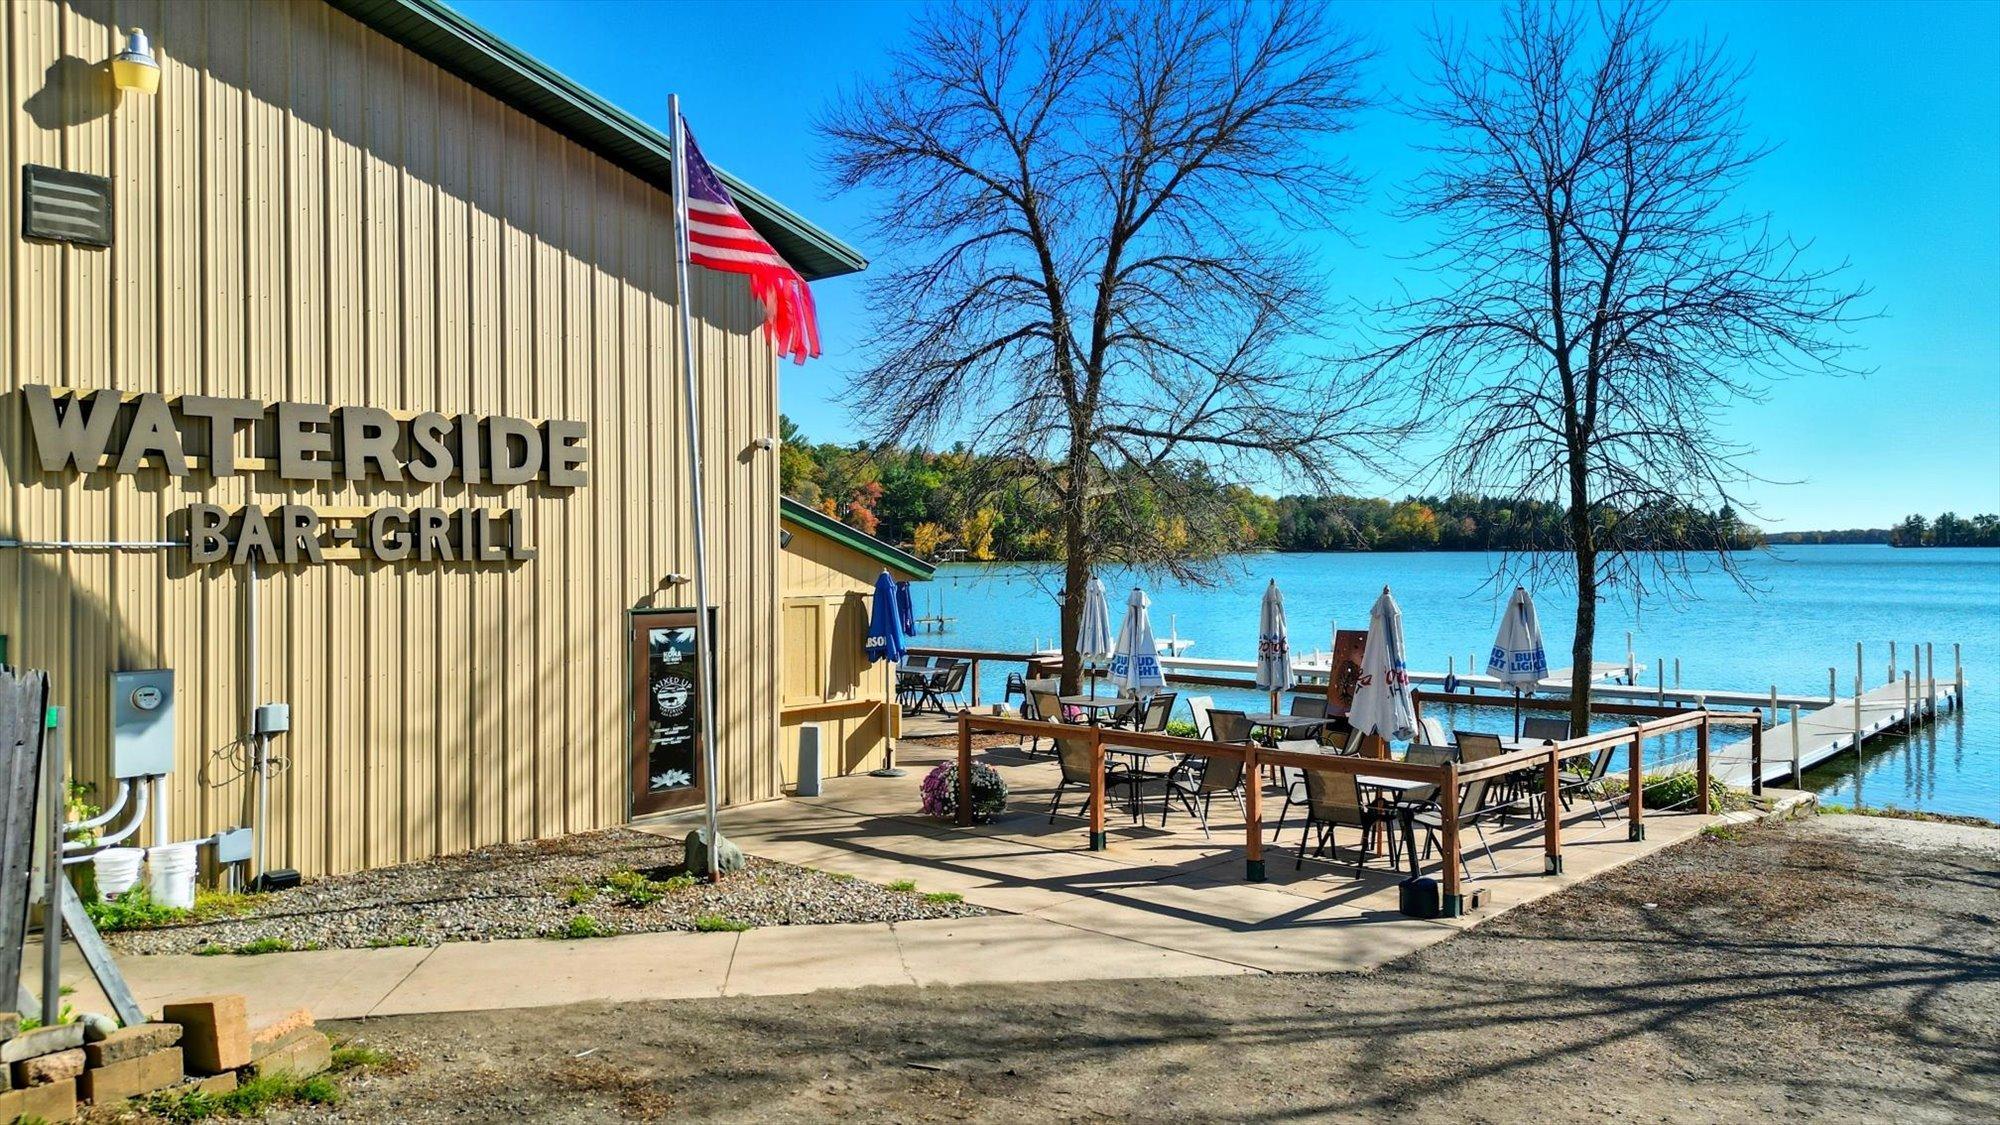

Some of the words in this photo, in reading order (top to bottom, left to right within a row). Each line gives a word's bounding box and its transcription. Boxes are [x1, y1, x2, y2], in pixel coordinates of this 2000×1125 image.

[24, 383, 588, 487] WATERSIDE
[653, 677, 679, 693] MIXED
[681, 679, 692, 689] UP
